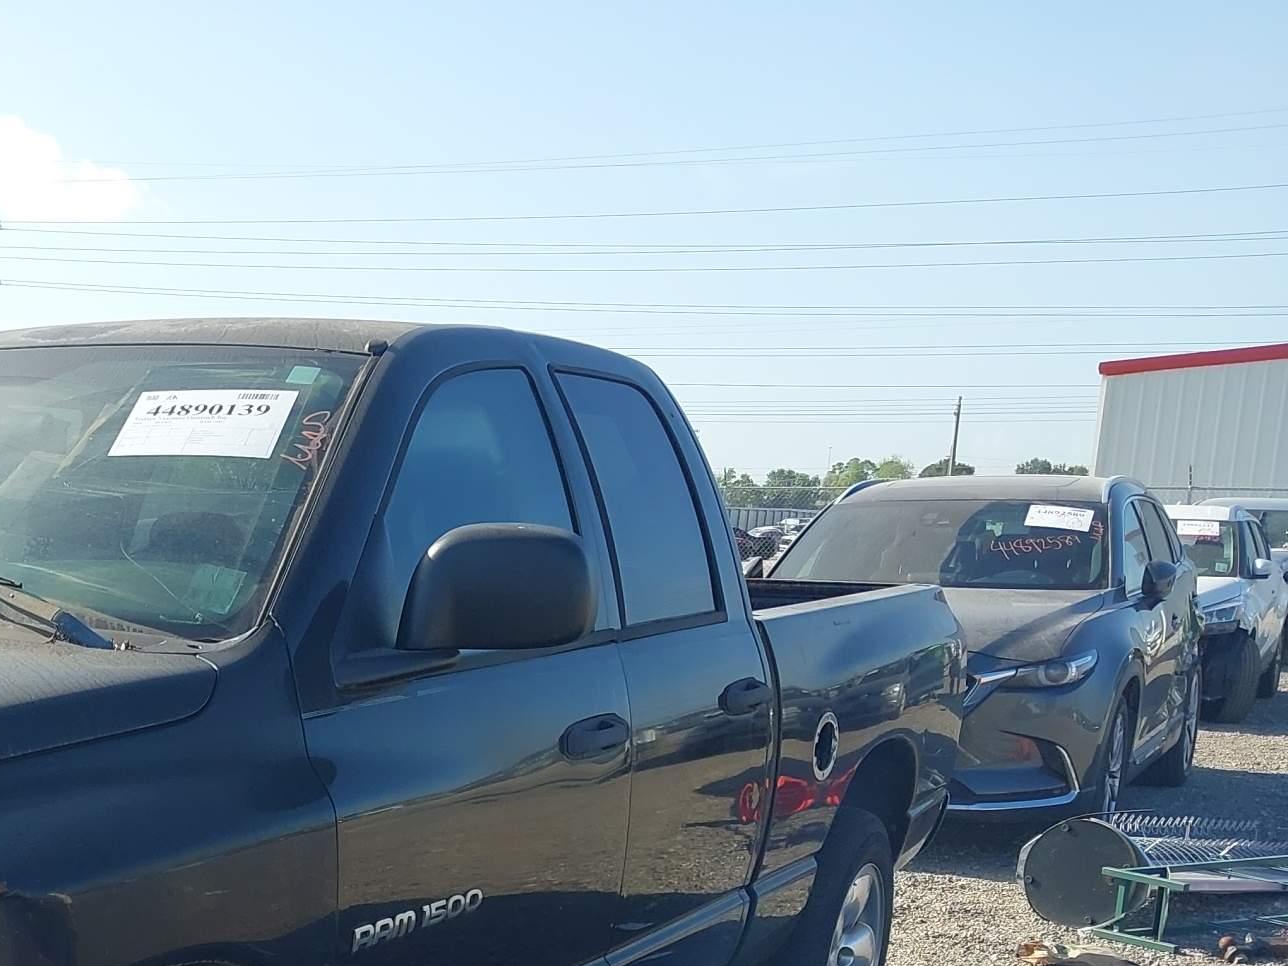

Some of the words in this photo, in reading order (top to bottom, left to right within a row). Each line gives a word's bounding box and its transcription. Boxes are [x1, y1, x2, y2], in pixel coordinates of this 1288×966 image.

[146, 403, 272, 417] 44890139
[352, 910, 416, 952] RAM
[421, 888, 483, 927] 1500
